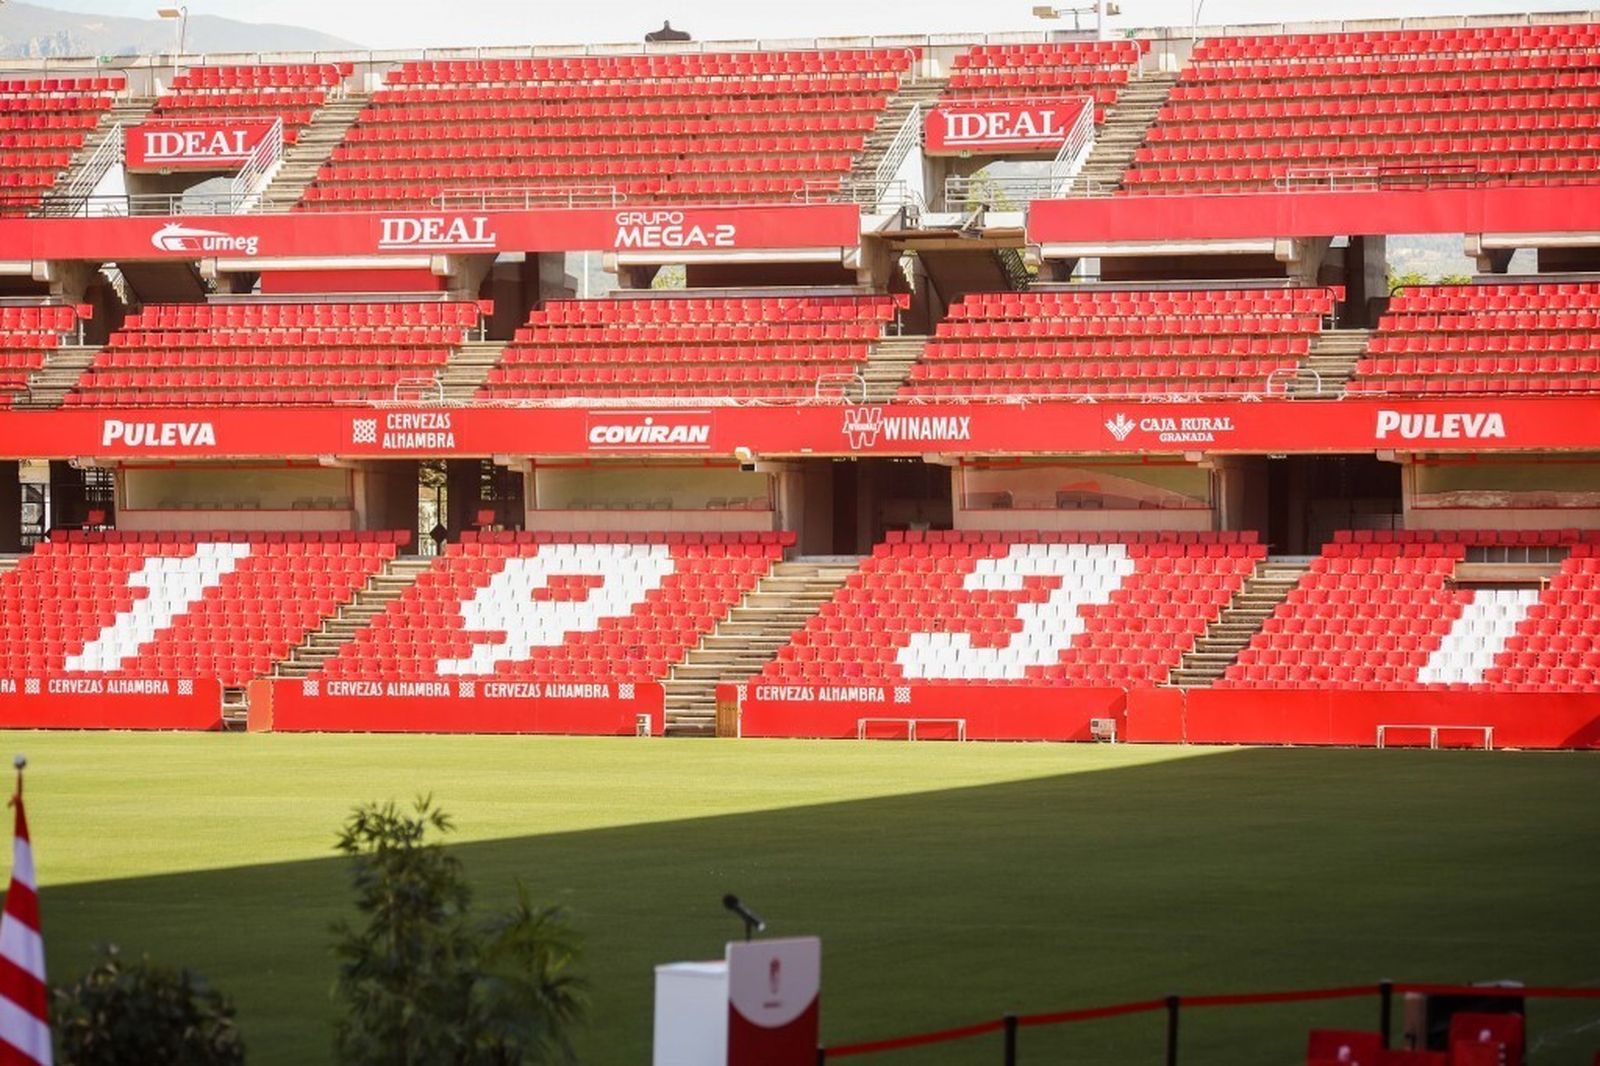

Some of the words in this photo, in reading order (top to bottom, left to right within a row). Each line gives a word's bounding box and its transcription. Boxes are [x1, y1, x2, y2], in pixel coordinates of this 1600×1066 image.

[943, 110, 1064, 140] IDEAL
[144, 130, 256, 157] IDEAL
[615, 211, 684, 225] GRUPO
[379, 217, 496, 244] IDEAL
[614, 224, 736, 248] MEGA-2
[202, 235, 259, 255] umeg
[386, 413, 452, 430] CERVEZAS
[883, 416, 970, 440] WINAMAX
[1140, 418, 1177, 432] CAJA
[1180, 417, 1235, 431] RURAL
[1375, 410, 1506, 439] PULEVA
[102, 420, 216, 446] PULEVA
[382, 432, 455, 449] ALHAMBRA
[1158, 432, 1214, 442] GRANADA
[437, 544, 676, 676] 9
[897, 543, 1135, 679] 3
[48, 679, 104, 694] CERVEZAS
[106, 680, 170, 694] ALHAMBRA
[327, 681, 383, 697] CERVEZAS
[386, 682, 451, 697] ALHAMBRA
[484, 682, 541, 698] CERVEZAS
[544, 683, 610, 698] ALHAMBRA
[755, 685, 815, 701] CERVEZAS
[818, 687, 886, 702] ALHAMBRA
